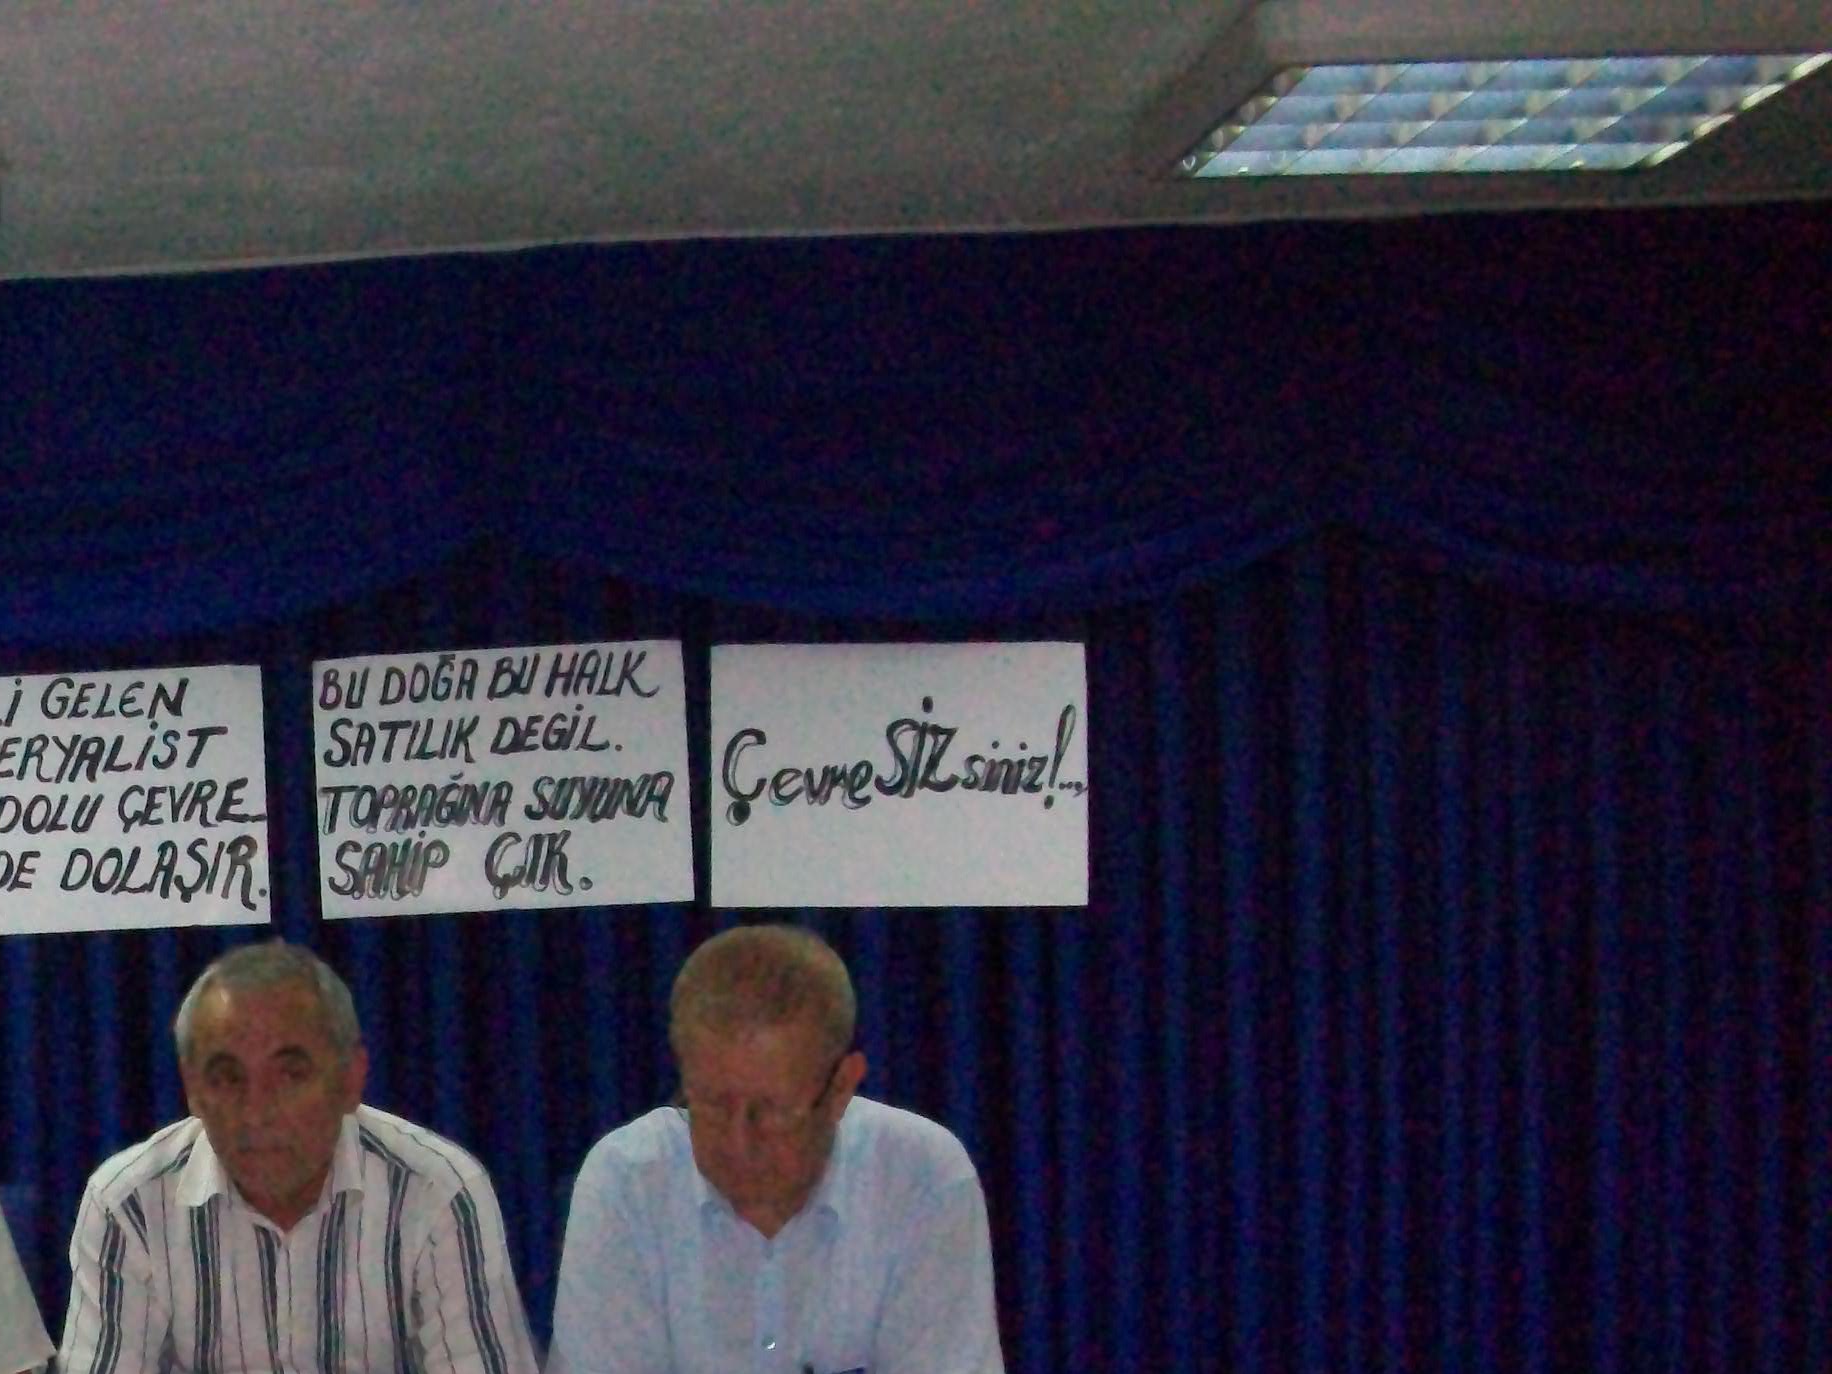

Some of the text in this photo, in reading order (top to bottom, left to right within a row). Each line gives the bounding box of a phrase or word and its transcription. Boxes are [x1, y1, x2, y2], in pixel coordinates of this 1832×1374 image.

[40, 677, 189, 720] GELEN
[319, 649, 659, 710] BU DOĞA BU HALK
[323, 714, 479, 767] SATILIK
[60, 835, 267, 911] DOLAŞIR.
[328, 829, 593, 900] SAHİP ÇIK.
